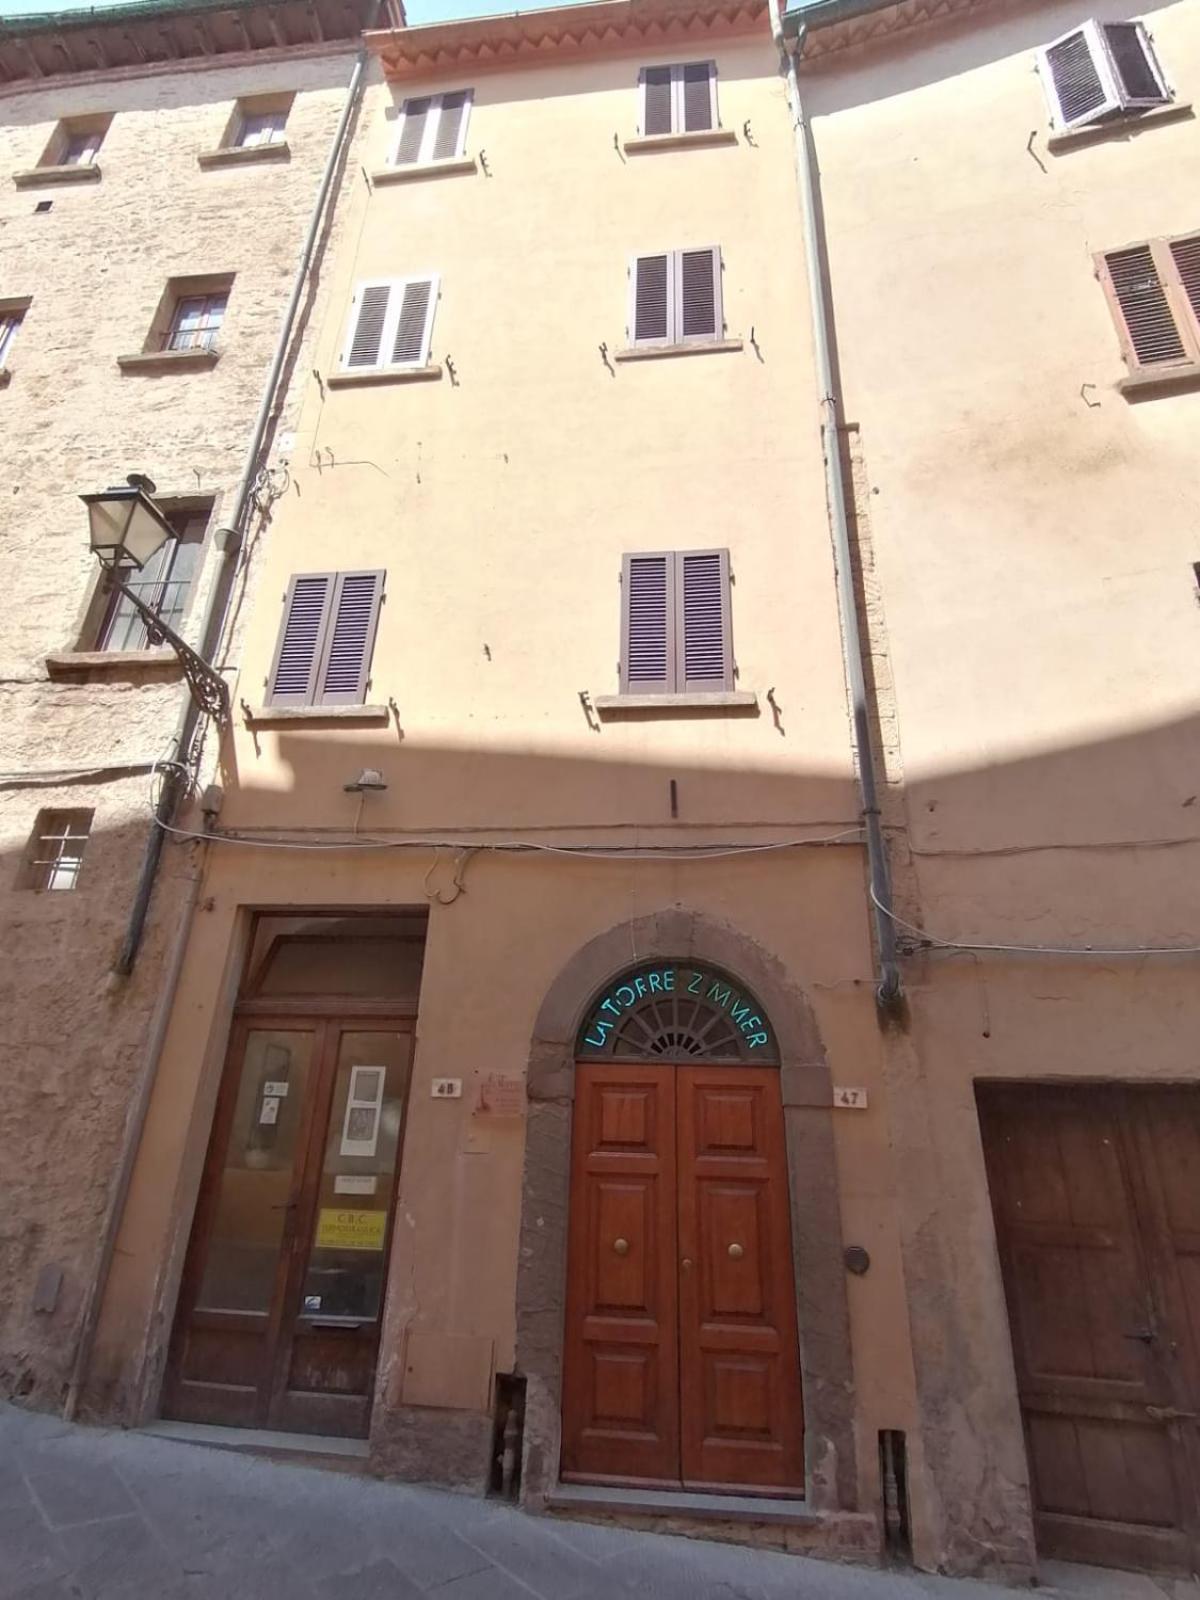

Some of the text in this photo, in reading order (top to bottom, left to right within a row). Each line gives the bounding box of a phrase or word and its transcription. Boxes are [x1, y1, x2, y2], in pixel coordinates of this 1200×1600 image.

[584, 1020, 615, 1047] LA
[600, 970, 676, 1016] TORRE
[840, 1091, 859, 1105] 47
